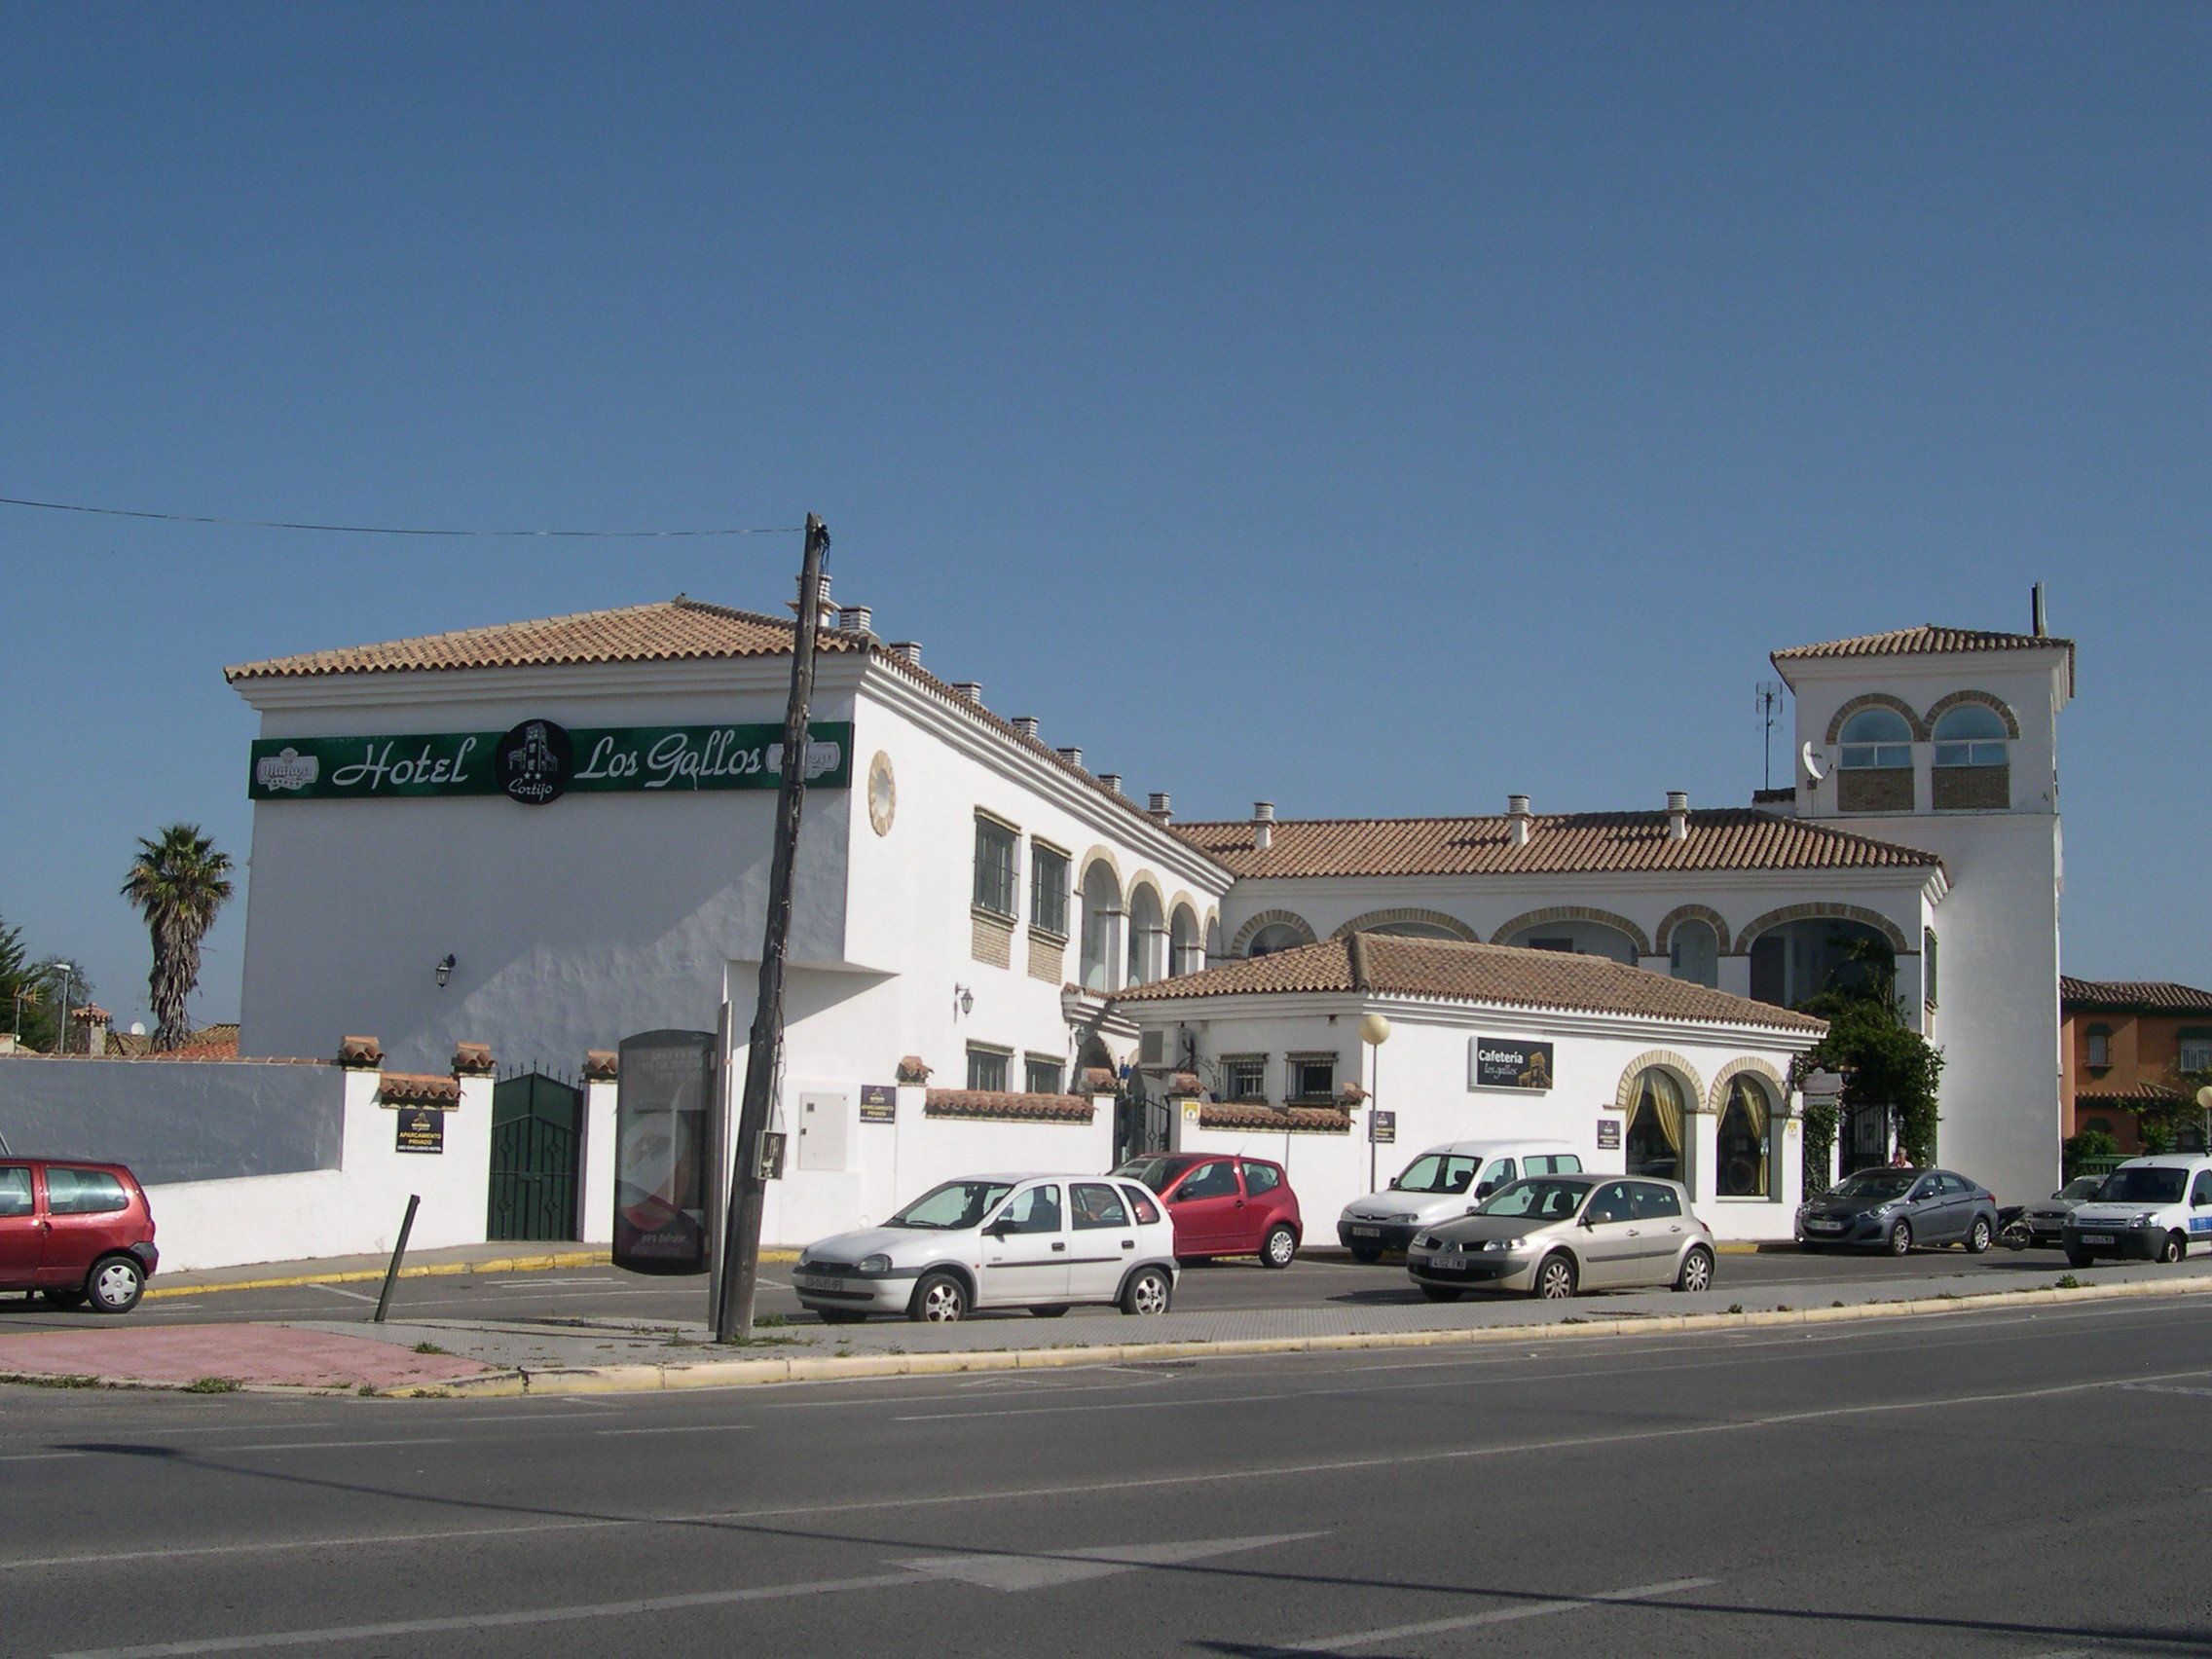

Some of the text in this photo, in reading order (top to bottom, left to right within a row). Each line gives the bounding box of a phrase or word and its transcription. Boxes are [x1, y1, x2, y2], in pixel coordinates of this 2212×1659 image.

[332, 729, 761, 790] Hotel Los Gallos
